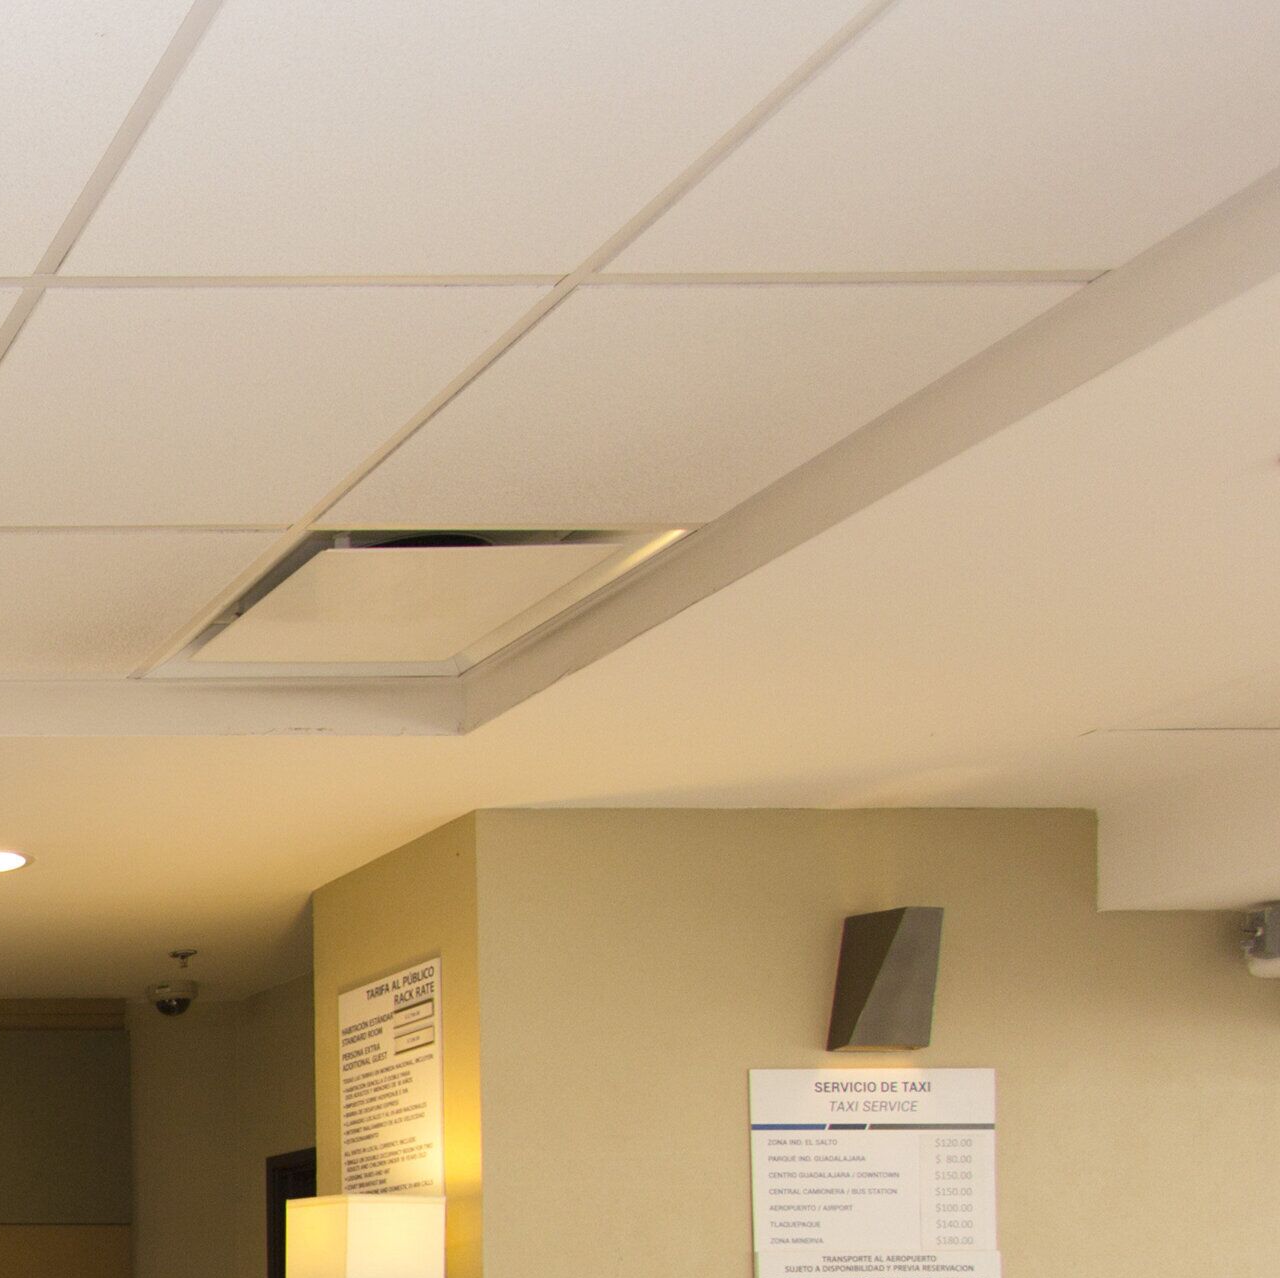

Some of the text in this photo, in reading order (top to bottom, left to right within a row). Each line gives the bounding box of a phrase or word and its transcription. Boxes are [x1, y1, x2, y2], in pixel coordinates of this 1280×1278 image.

[366, 966, 434, 1000] TARIFA AL PÚBLICO
[394, 981, 434, 1005] RACK RATE
[342, 1027, 383, 1047] STANDARD ROOM
[342, 1043, 380, 1062] PERSONA EXTRA
[343, 1052, 387, 1071] ADDITIONAL GUEST
[814, 1082, 931, 1093] SERVICIO DE TAXI
[830, 1101, 919, 1112] TAXI SERVICE
[935, 1138, 972, 1148] $120.00
[946, 1155, 972, 1164] 80.00
[935, 1171, 972, 1180] $150.00
[935, 1187, 972, 1196] $150.00
[935, 1203, 973, 1212] $100.00
[936, 1219, 973, 1229] $140.00
[785, 1265, 813, 1273] SUJETO
[893, 1264, 920, 1272] PREVIA
